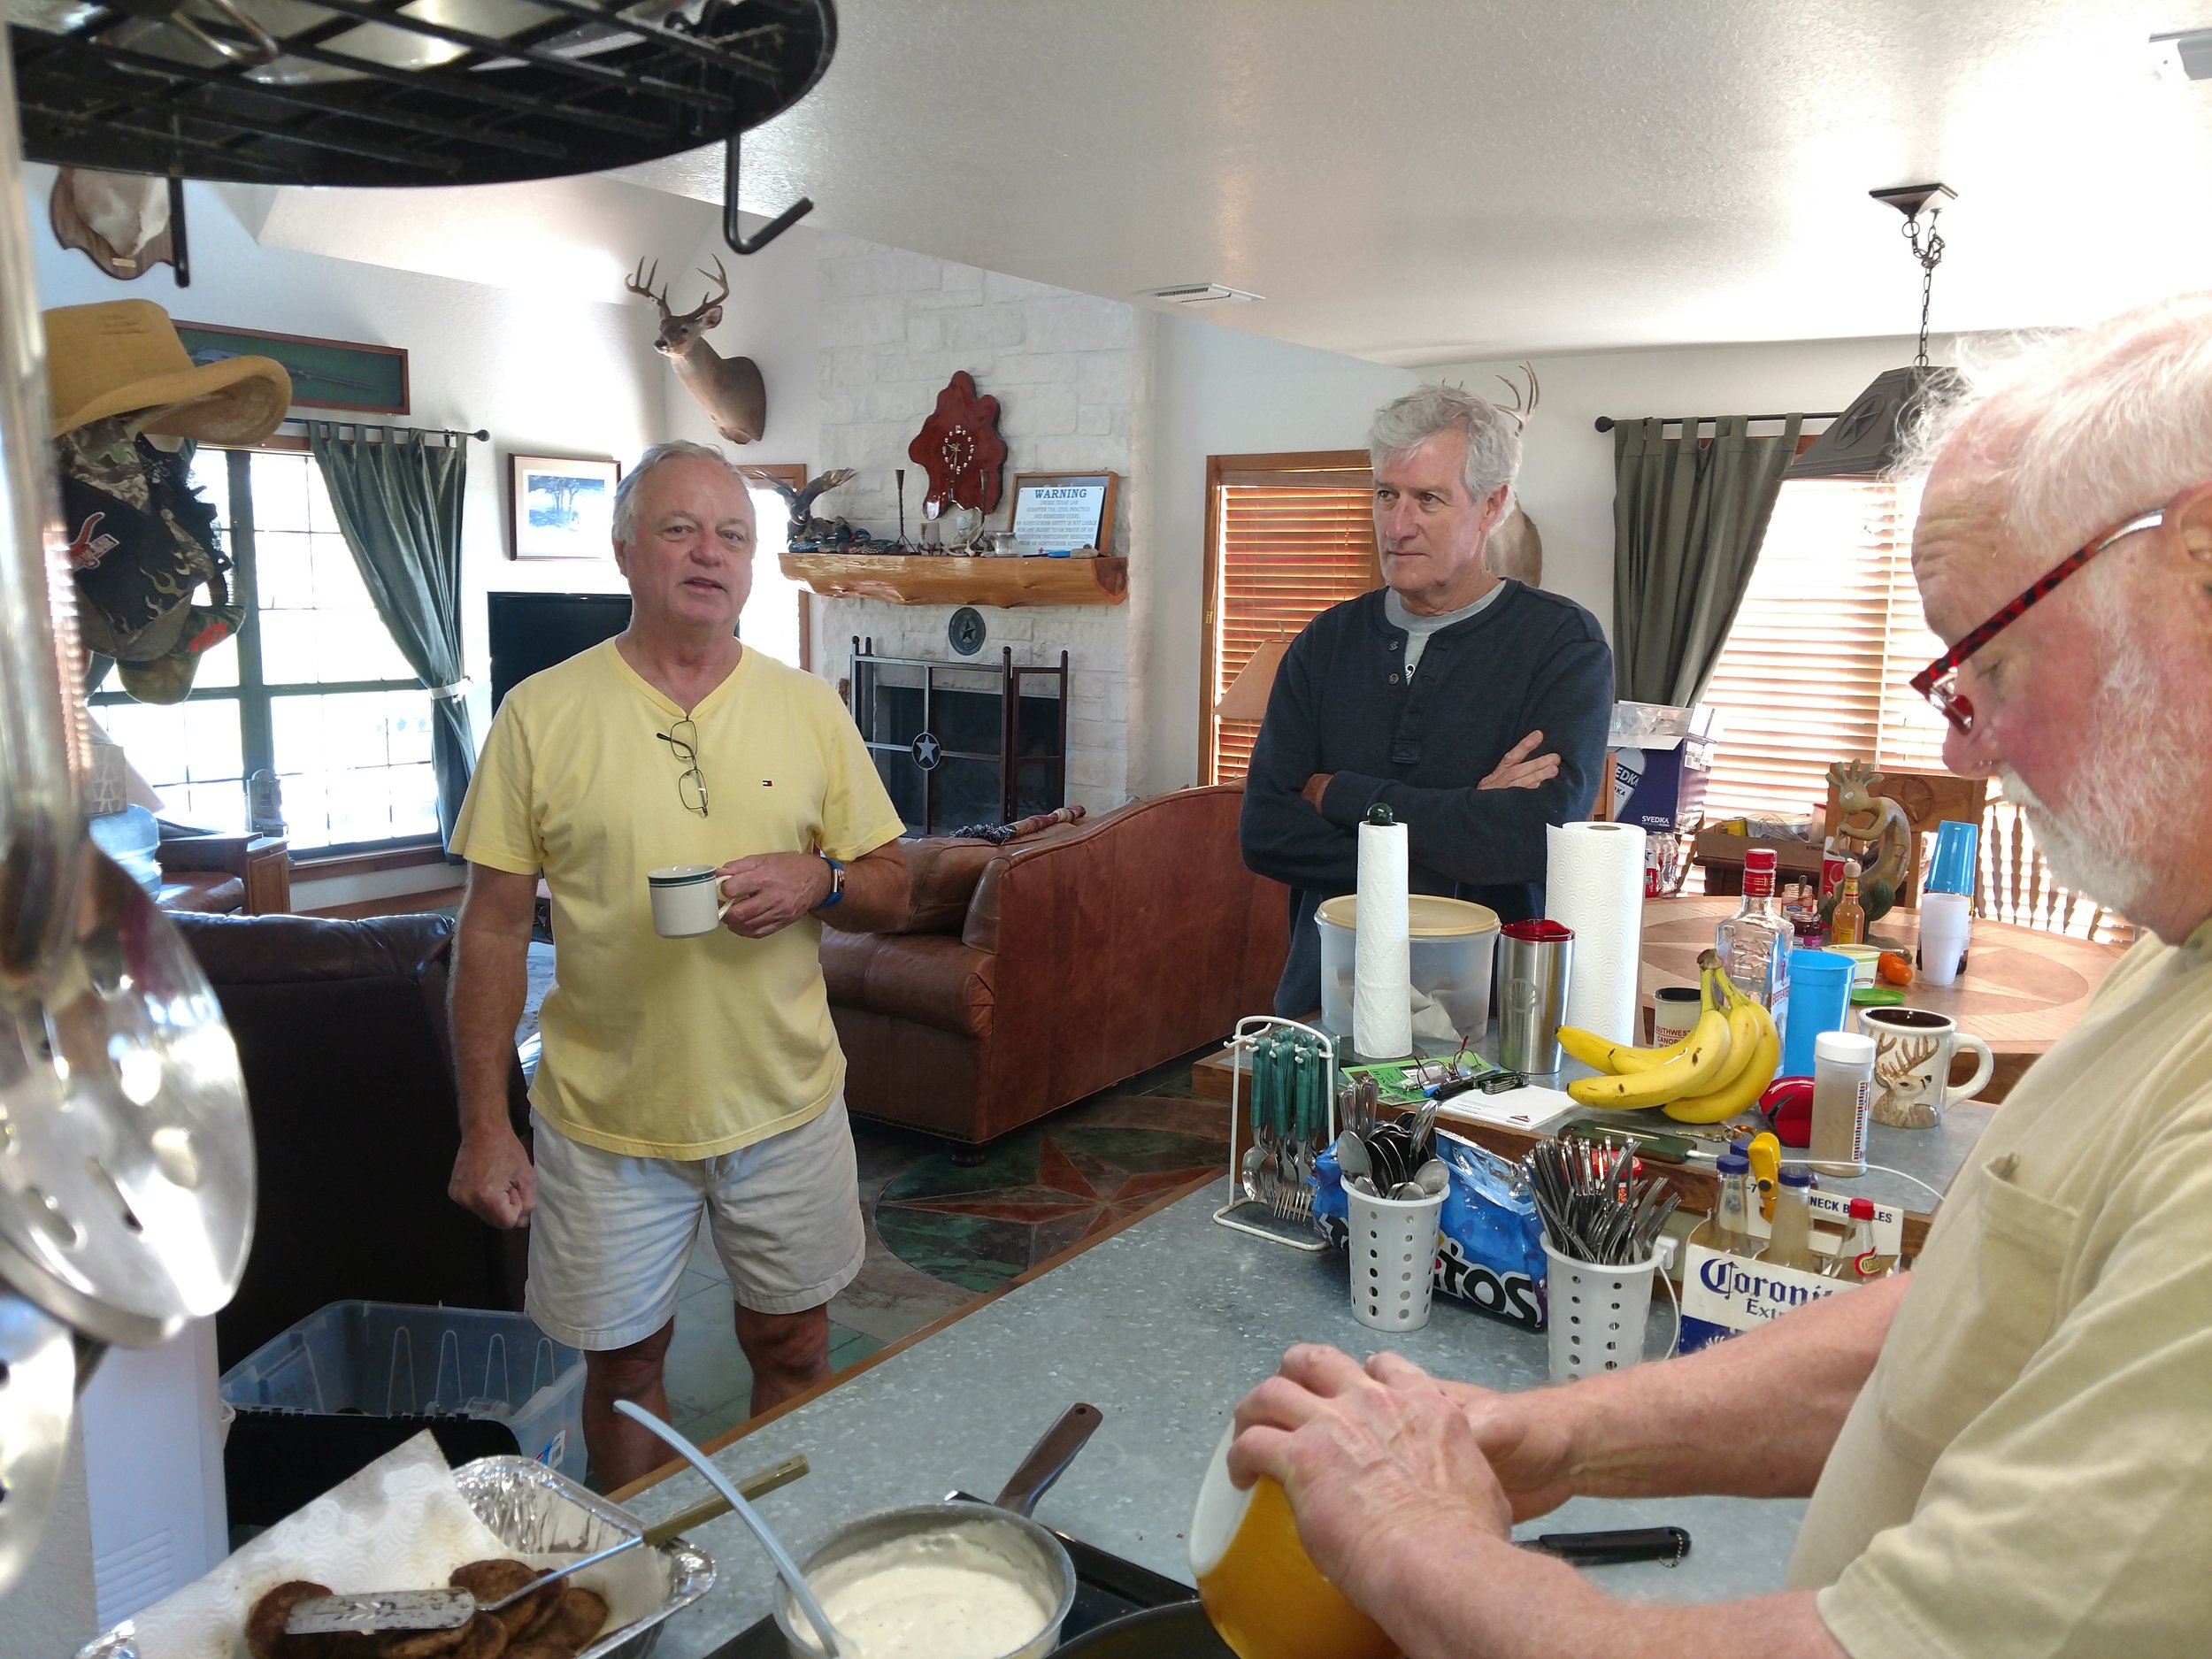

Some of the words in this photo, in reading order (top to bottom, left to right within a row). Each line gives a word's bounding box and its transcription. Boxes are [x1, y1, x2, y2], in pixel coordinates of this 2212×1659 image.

[1035, 489, 1087, 498] WARNING
[1641, 815, 1669, 824] SVEDKA
[1808, 1196, 1839, 1212] NECK
